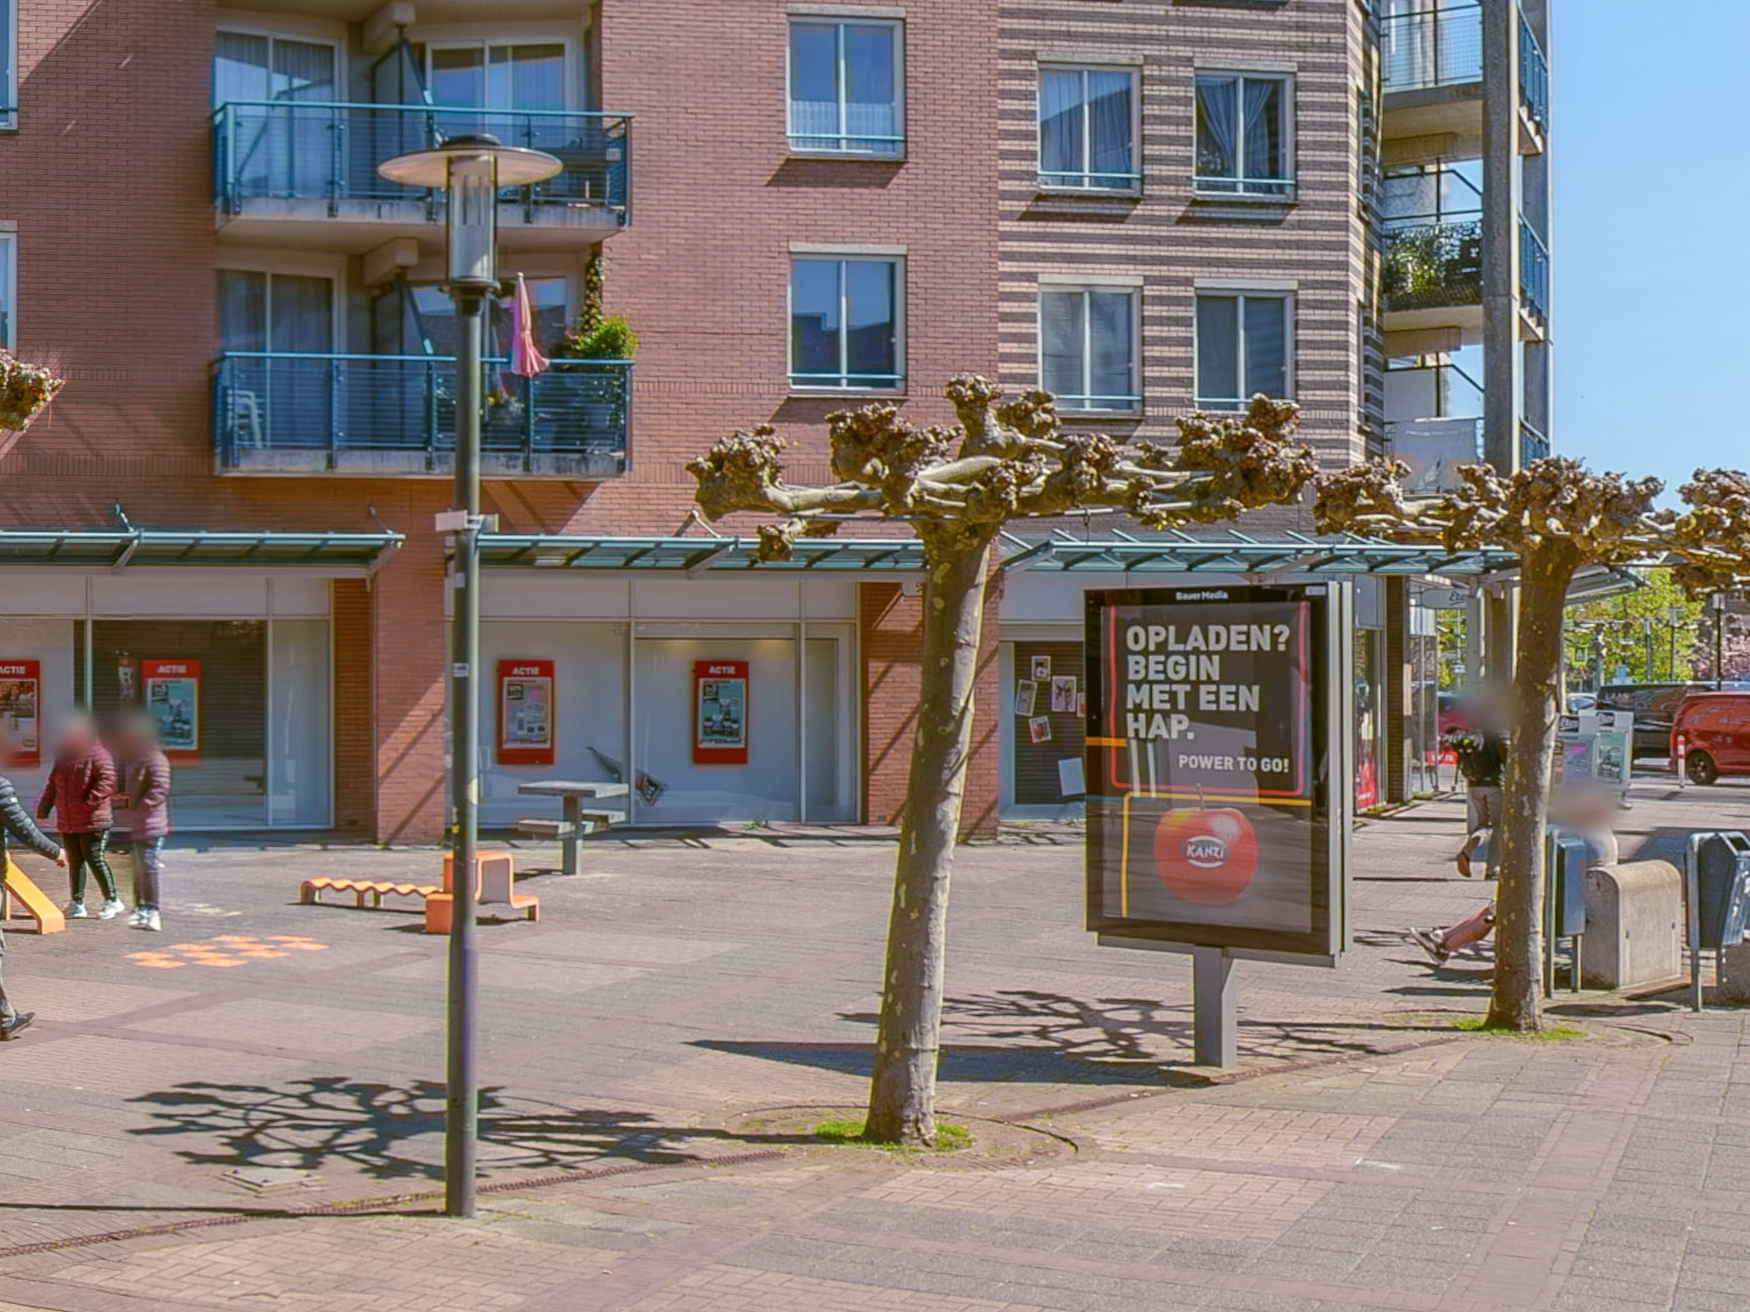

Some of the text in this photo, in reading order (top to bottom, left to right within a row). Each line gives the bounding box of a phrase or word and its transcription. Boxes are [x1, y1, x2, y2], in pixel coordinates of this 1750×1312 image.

[1176, 591, 1229, 601] Bauer Media
[1126, 624, 1291, 652] OPLADEN?
[156, 664, 186, 674] ACTIE
[512, 666, 540, 675] ACTIE
[708, 665, 736, 674] ACTIE
[1127, 654, 1220, 681] BEGIN
[1126, 683, 1260, 712] MET EEN
[1126, 713, 1195, 740] HAP.
[1178, 754, 1289, 773] POWER TO GO!
